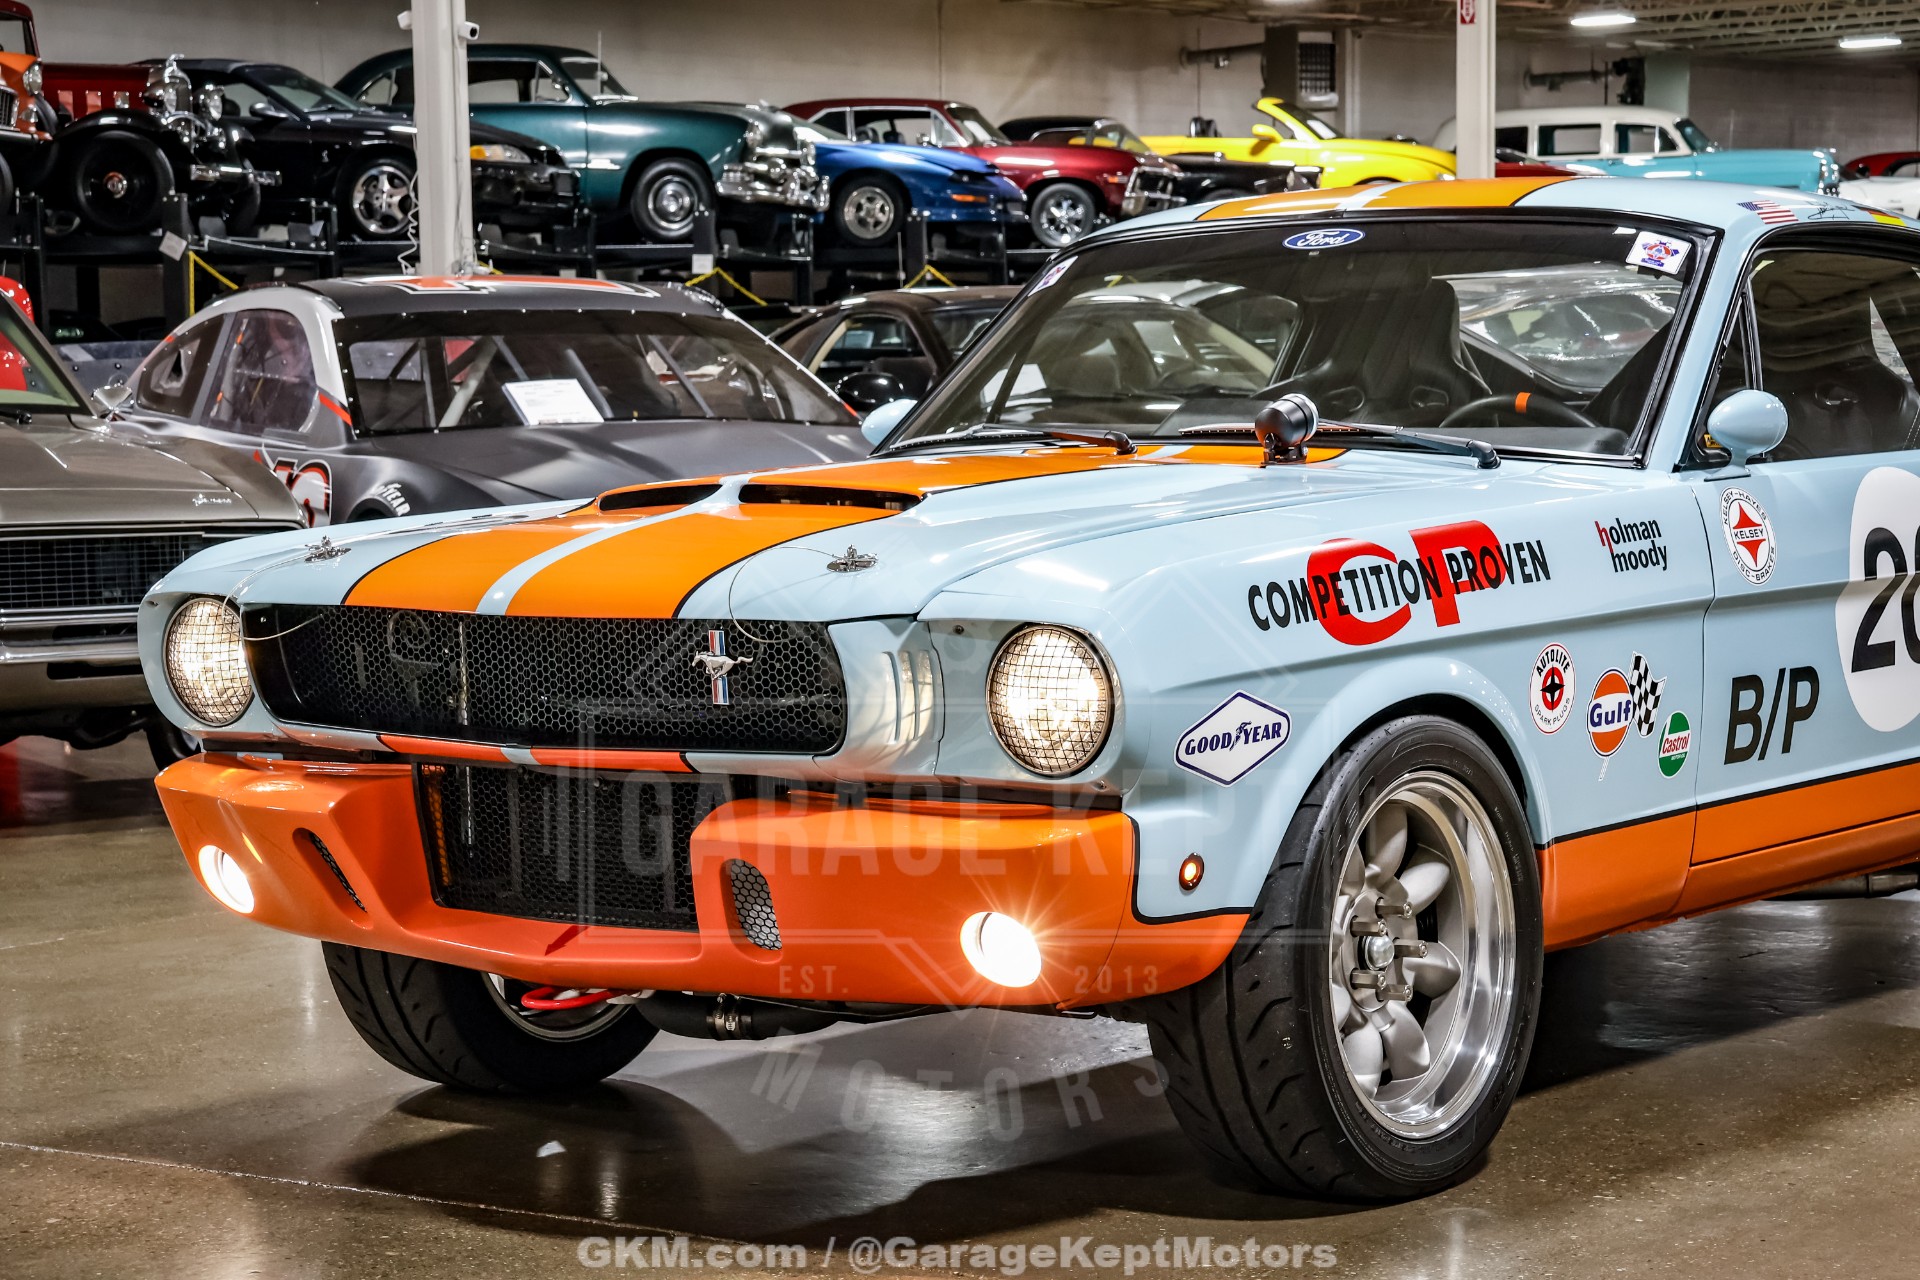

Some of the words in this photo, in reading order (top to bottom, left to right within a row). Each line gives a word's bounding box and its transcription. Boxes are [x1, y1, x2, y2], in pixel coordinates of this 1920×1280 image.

[1297, 231, 1350, 247] Ford
[1594, 517, 1662, 552] holman
[1733, 528, 1764, 540] KELSEY
[1610, 539, 1668, 573] moody
[1248, 556, 1443, 631] COMPETITION
[1446, 539, 1552, 595] PROVEN
[1535, 649, 1571, 678] AUTOLITE
[1534, 704, 1552, 726] SPARK
[1590, 699, 1632, 728] Gulf
[1724, 665, 1820, 765] B/P
[1662, 732, 1691, 755] Castrol
